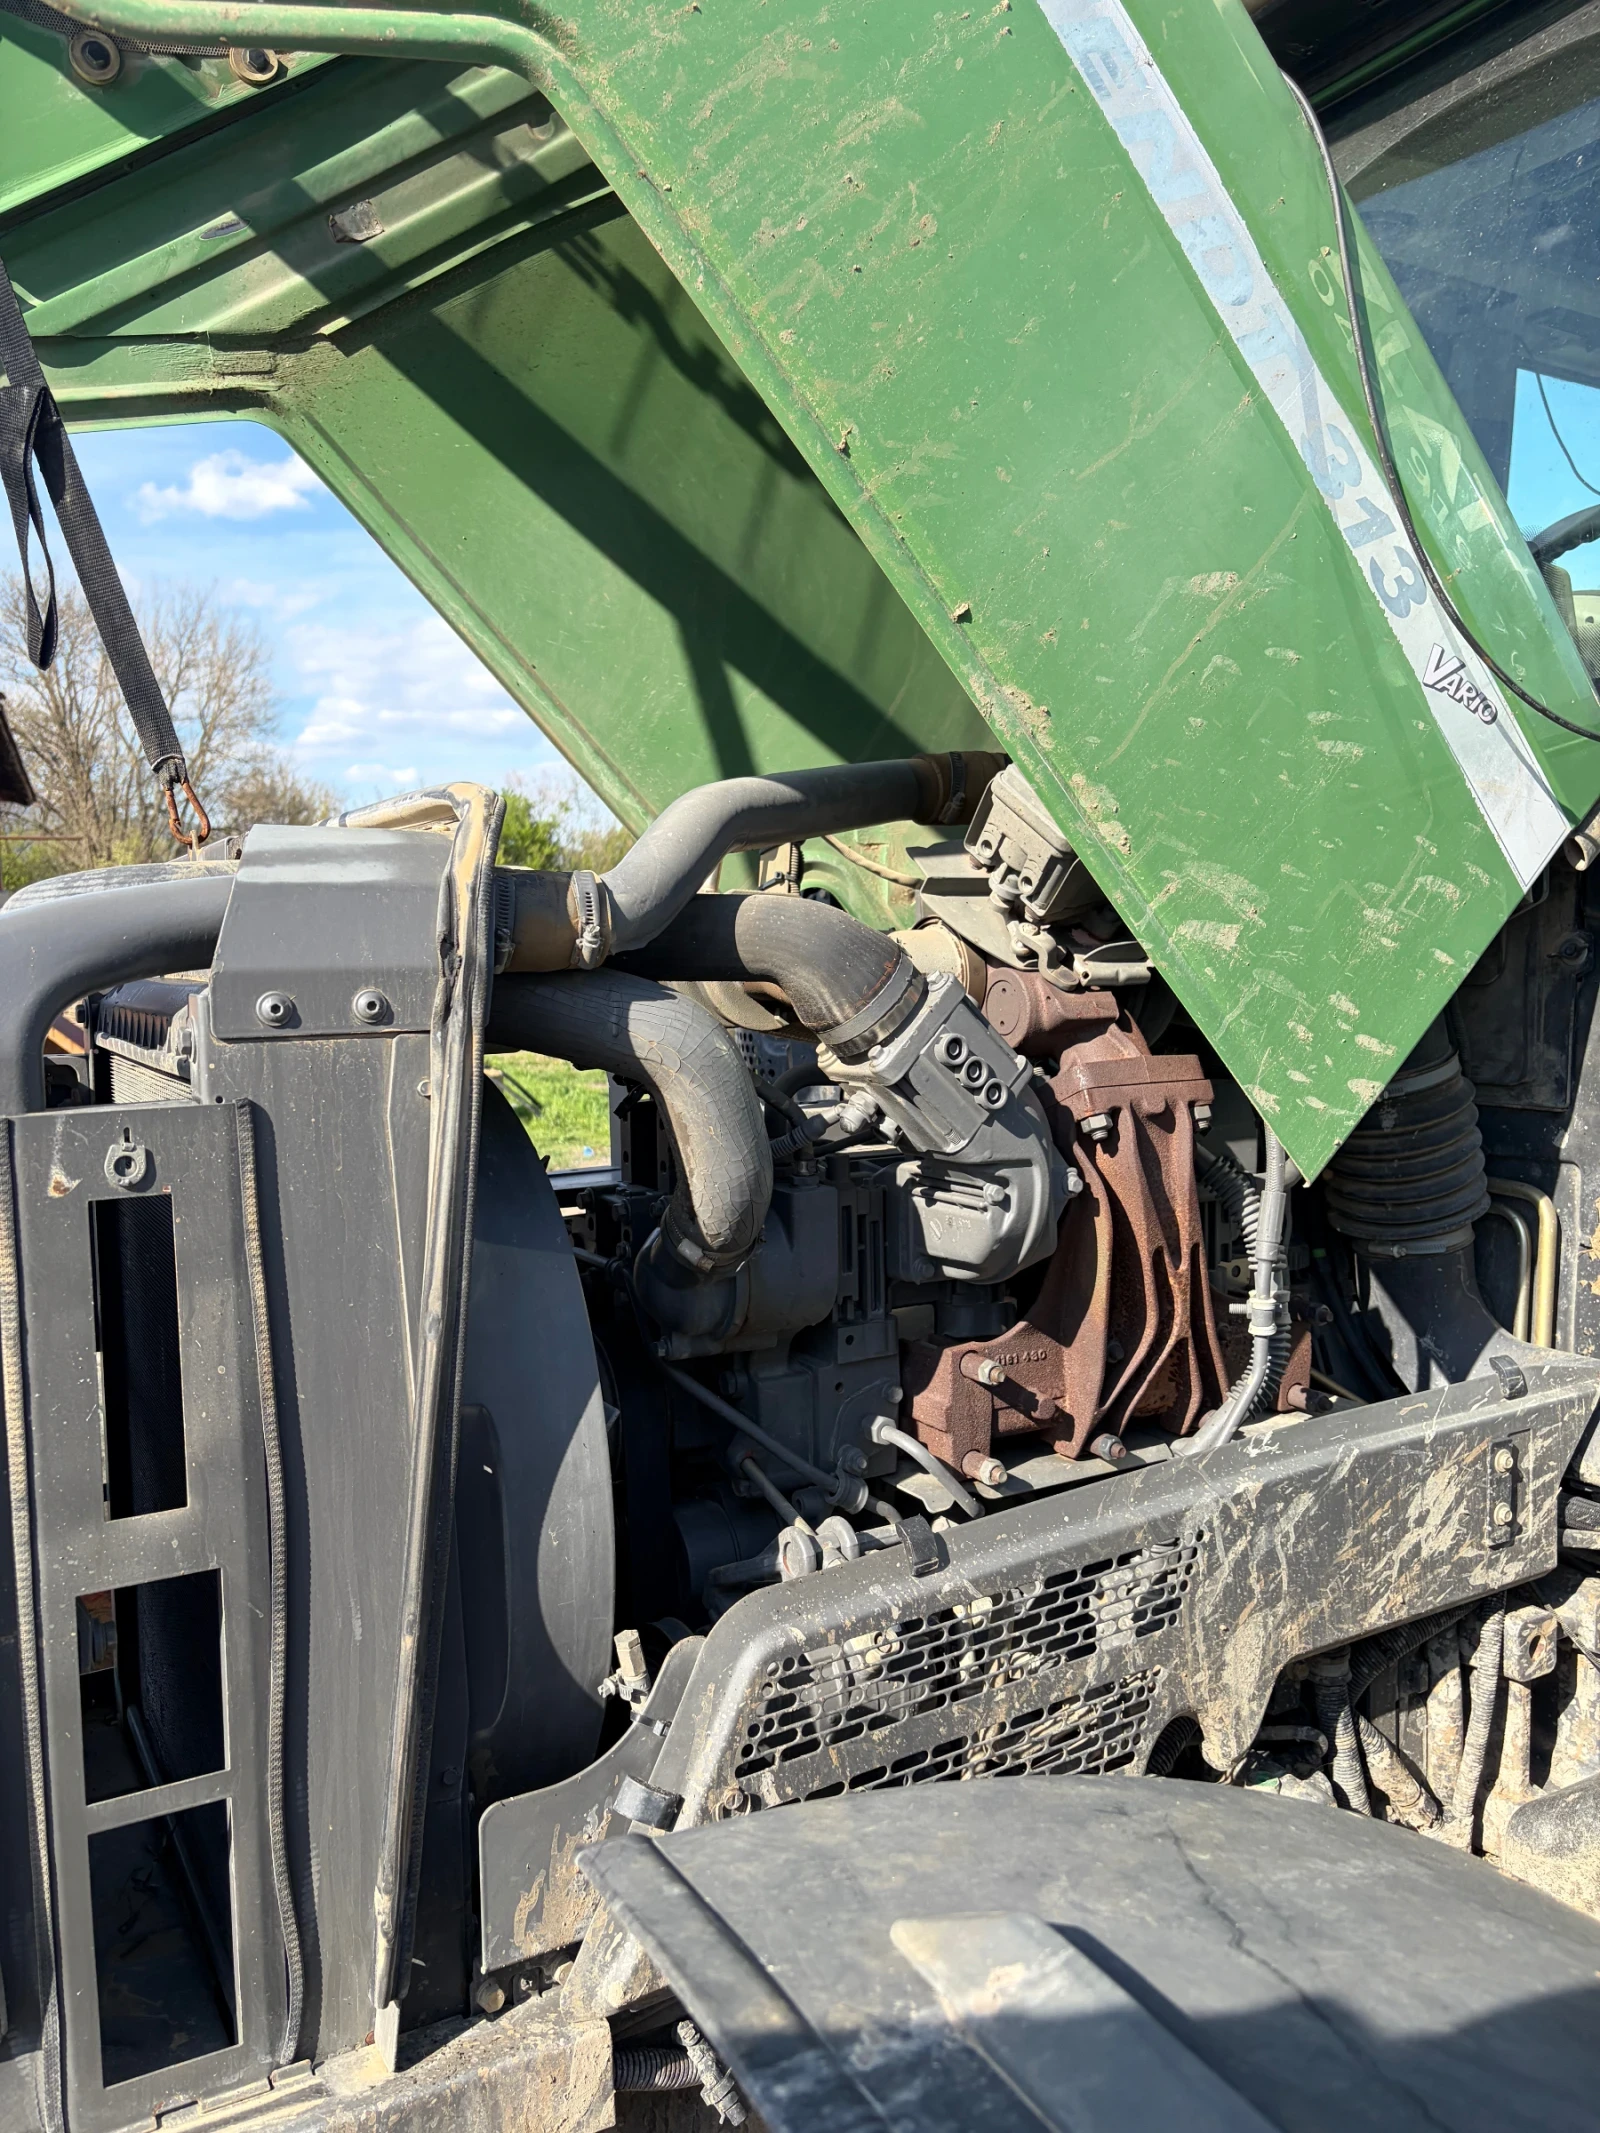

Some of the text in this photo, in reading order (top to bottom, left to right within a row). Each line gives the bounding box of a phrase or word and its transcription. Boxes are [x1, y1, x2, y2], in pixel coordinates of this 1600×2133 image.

[1056, 0, 1305, 372] ENDT
[1301, 423, 1427, 619] 313
[1422, 642, 1499, 725] VARIO
